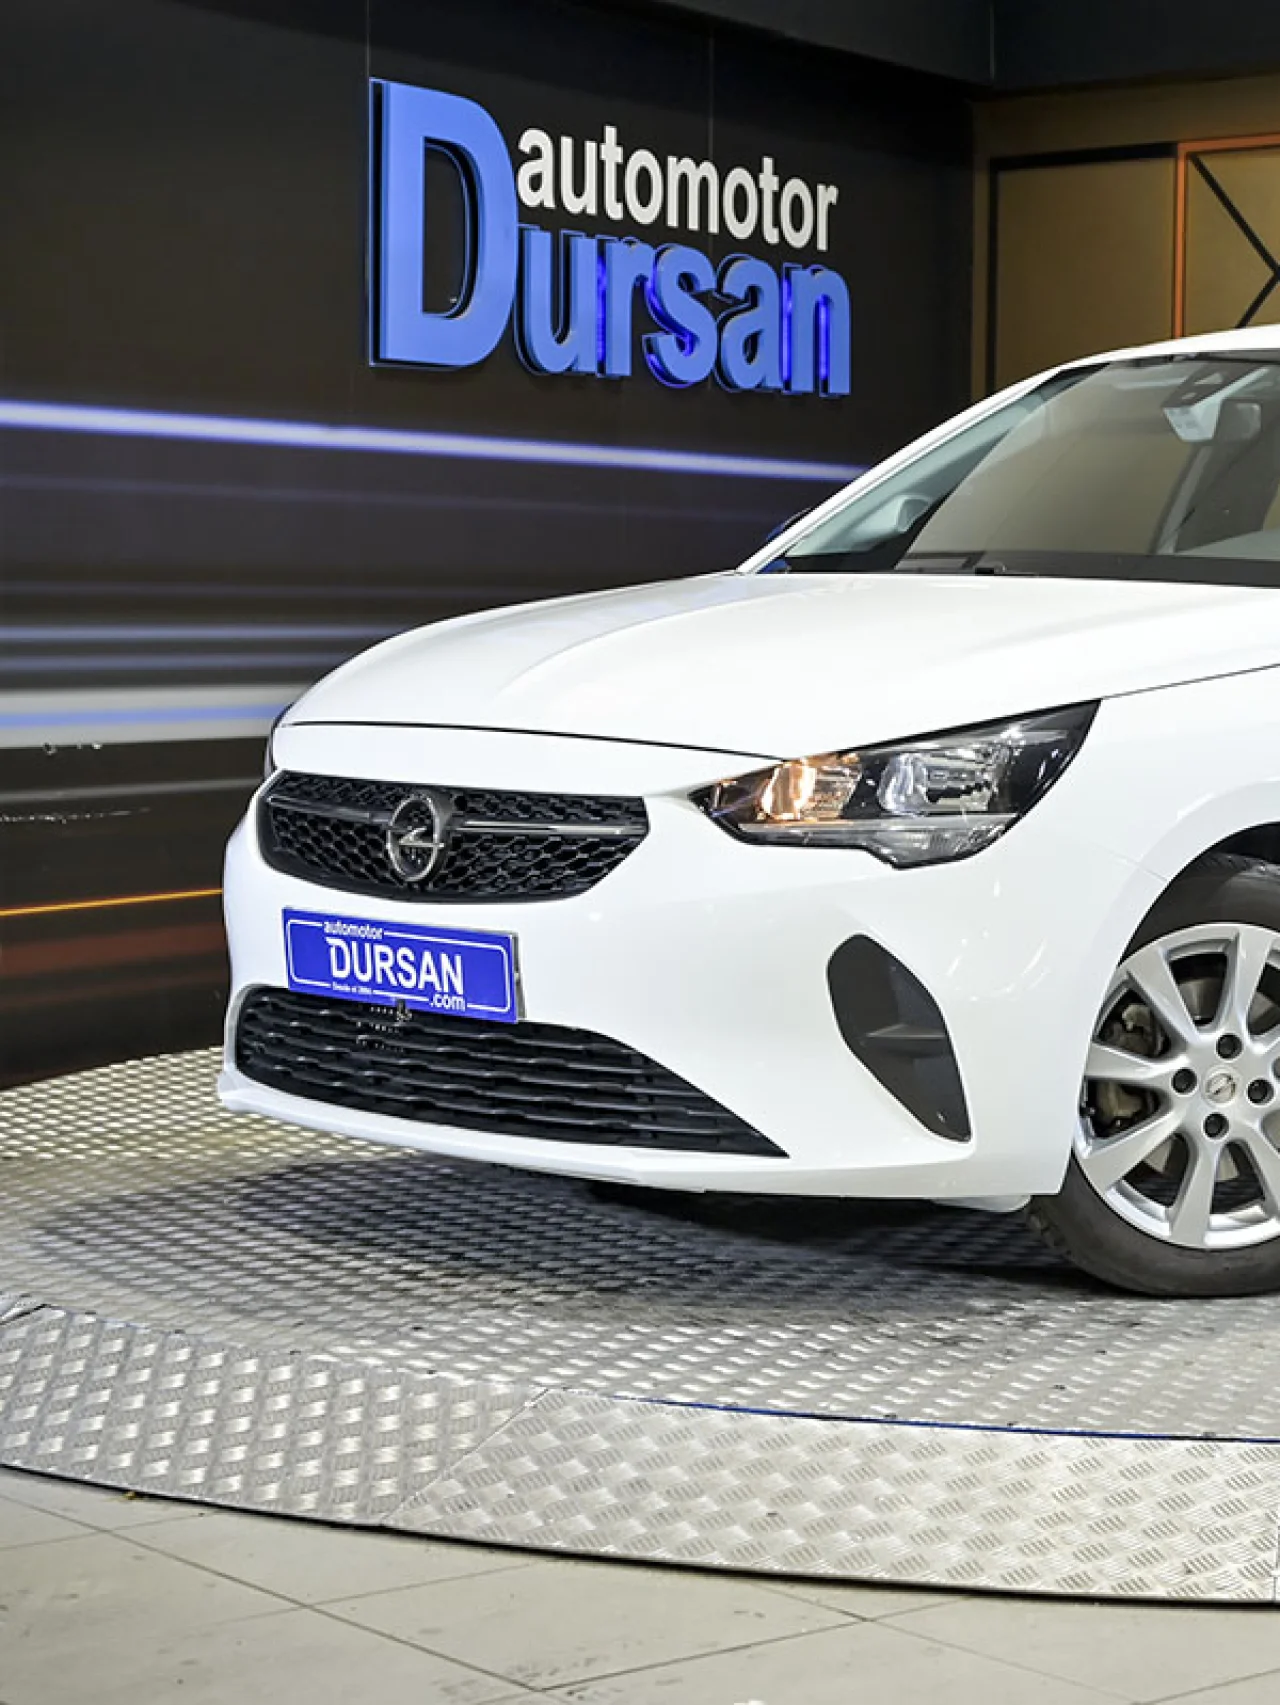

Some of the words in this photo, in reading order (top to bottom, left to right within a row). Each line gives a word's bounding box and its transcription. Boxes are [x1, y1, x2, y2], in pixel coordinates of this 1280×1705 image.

[517, 125, 839, 251] automotor
[369, 76, 852, 398] Dursan
[323, 919, 383, 940] automotor
[325, 936, 464, 995] DURSAN
[430, 994, 466, 1012] .com
